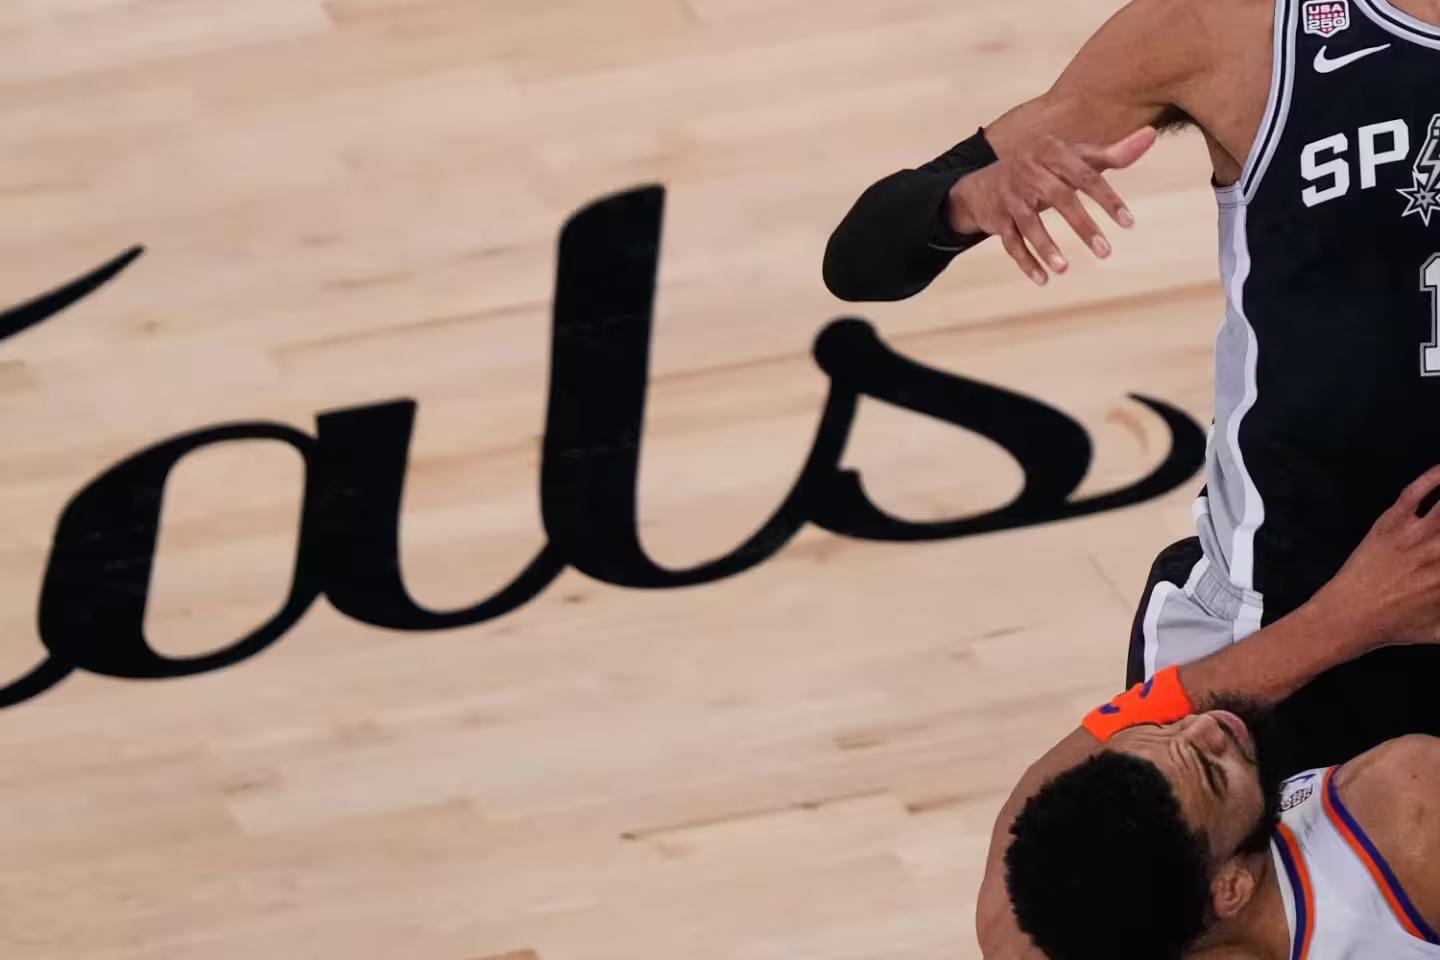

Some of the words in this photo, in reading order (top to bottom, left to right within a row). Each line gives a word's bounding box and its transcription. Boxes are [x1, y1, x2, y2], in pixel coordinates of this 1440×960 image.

[1308, 3, 1343, 14] USA
[1308, 17, 1346, 31] 250
[0, 183, 1208, 708] als
